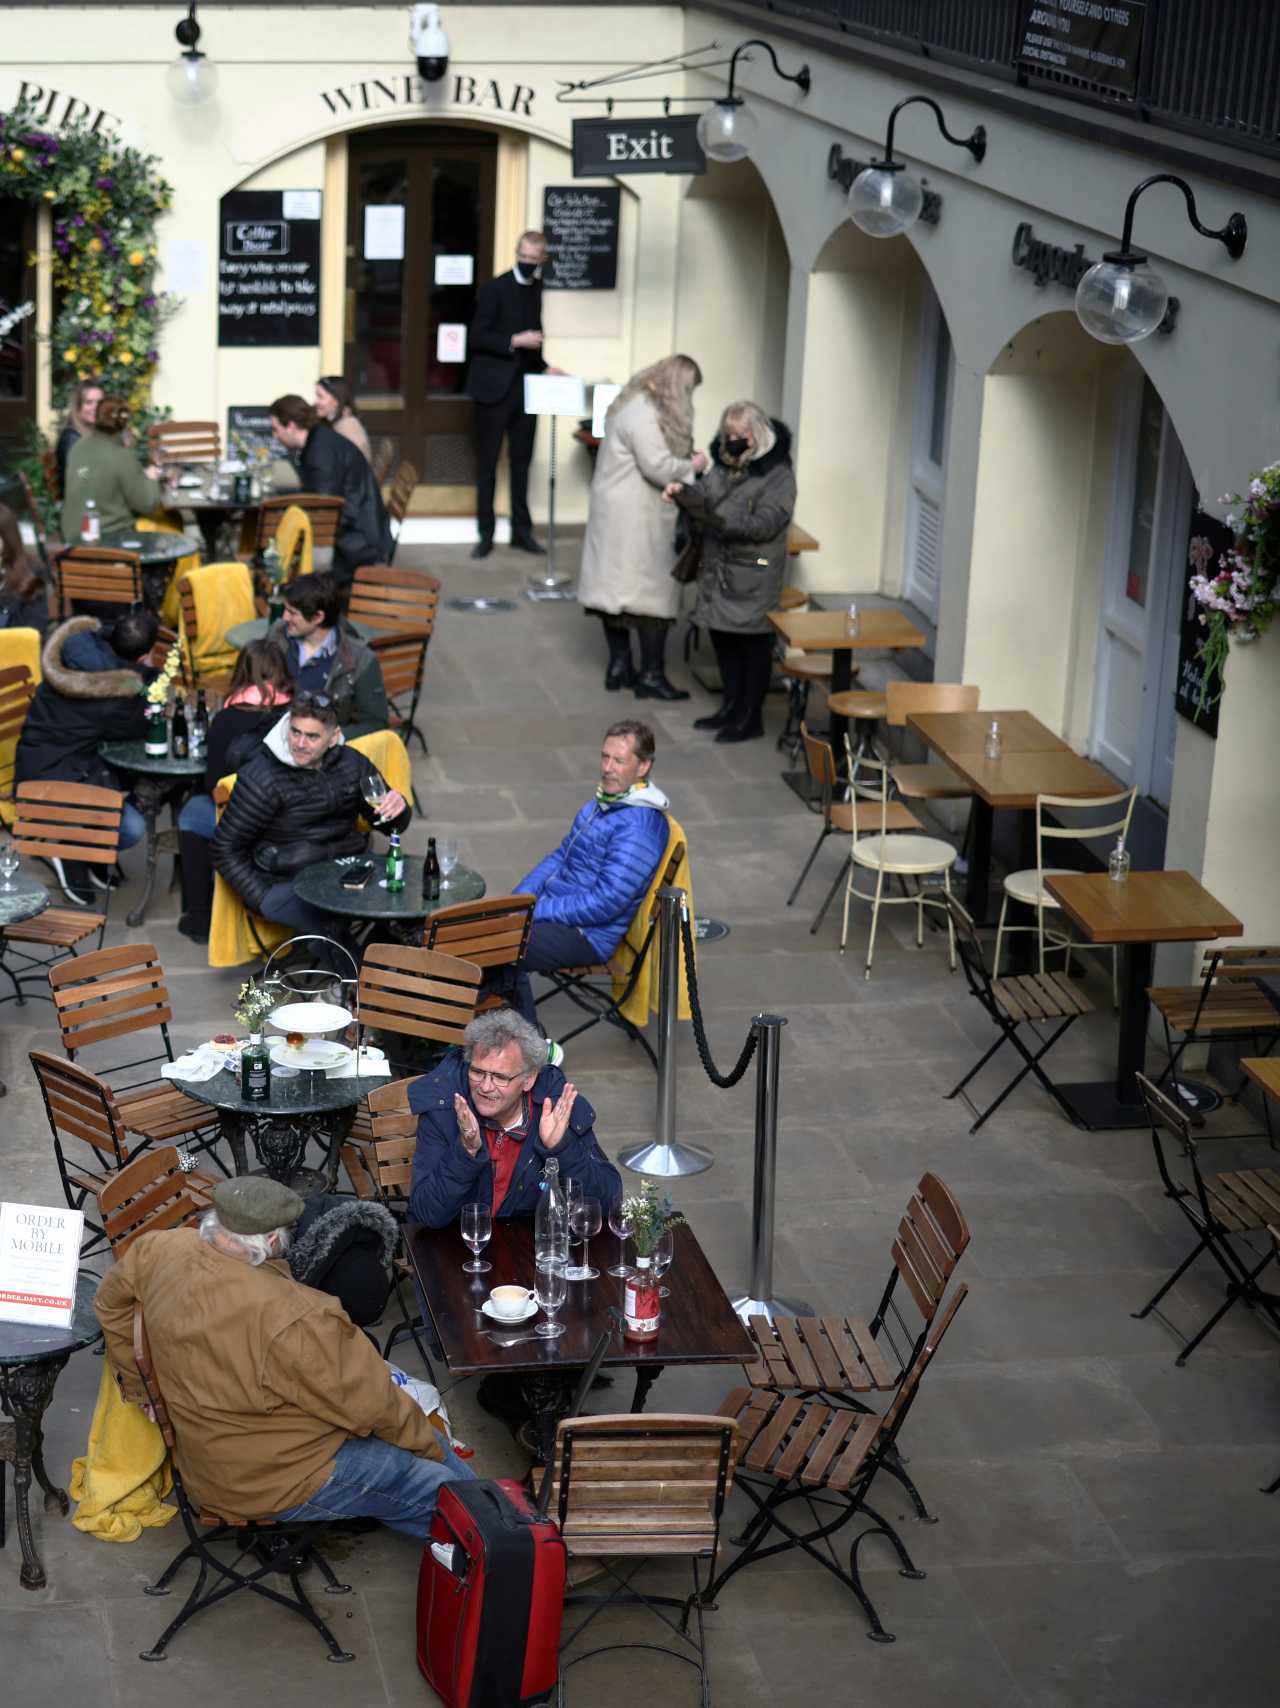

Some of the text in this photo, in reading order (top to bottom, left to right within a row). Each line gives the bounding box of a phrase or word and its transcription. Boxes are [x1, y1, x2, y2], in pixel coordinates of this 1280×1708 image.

[19, 80, 122, 136] PIPE
[320, 76, 535, 116] WINE BAR
[606, 129, 674, 161] Exit
[15, 1212, 65, 1229] ORDER
[31, 1227, 49, 1240] BY
[11, 1238, 65, 1255] MOBILE
